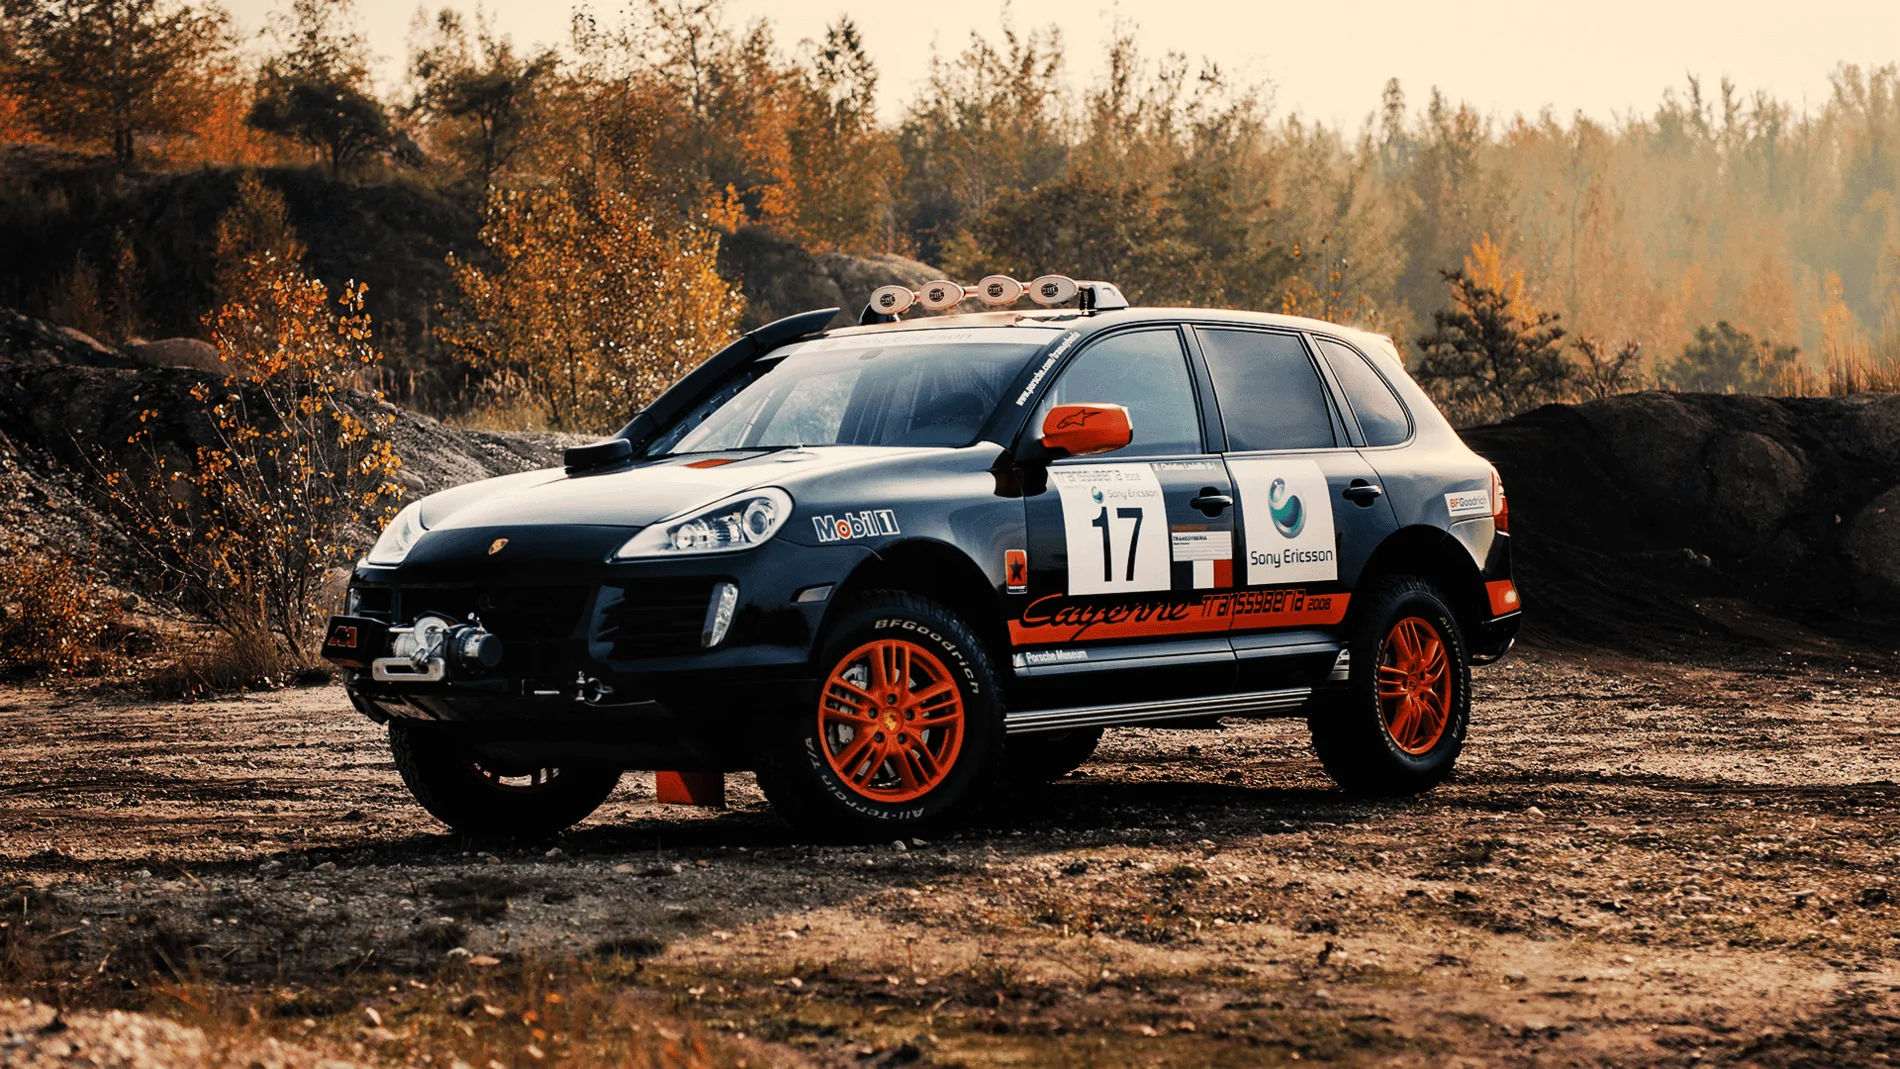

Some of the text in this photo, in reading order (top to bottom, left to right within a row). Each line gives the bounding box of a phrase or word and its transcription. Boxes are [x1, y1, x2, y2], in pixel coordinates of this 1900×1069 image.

[1107, 487, 1159, 500] Sony Ericsson
[1450, 496, 1487, 508] BFGoodrich
[811, 509, 900, 542] Mobil 1
[1092, 506, 1143, 582] 17
[1250, 551, 1281, 568] Sony
[1283, 548, 1333, 564] Ericsson
[1020, 593, 1190, 641] Cayenne
[1307, 597, 1332, 611] 2008
[874, 619, 980, 694] BFGoodrich
[1025, 649, 1089, 663] Porsche Museum
[804, 737, 925, 820] All-Terrain T/A
